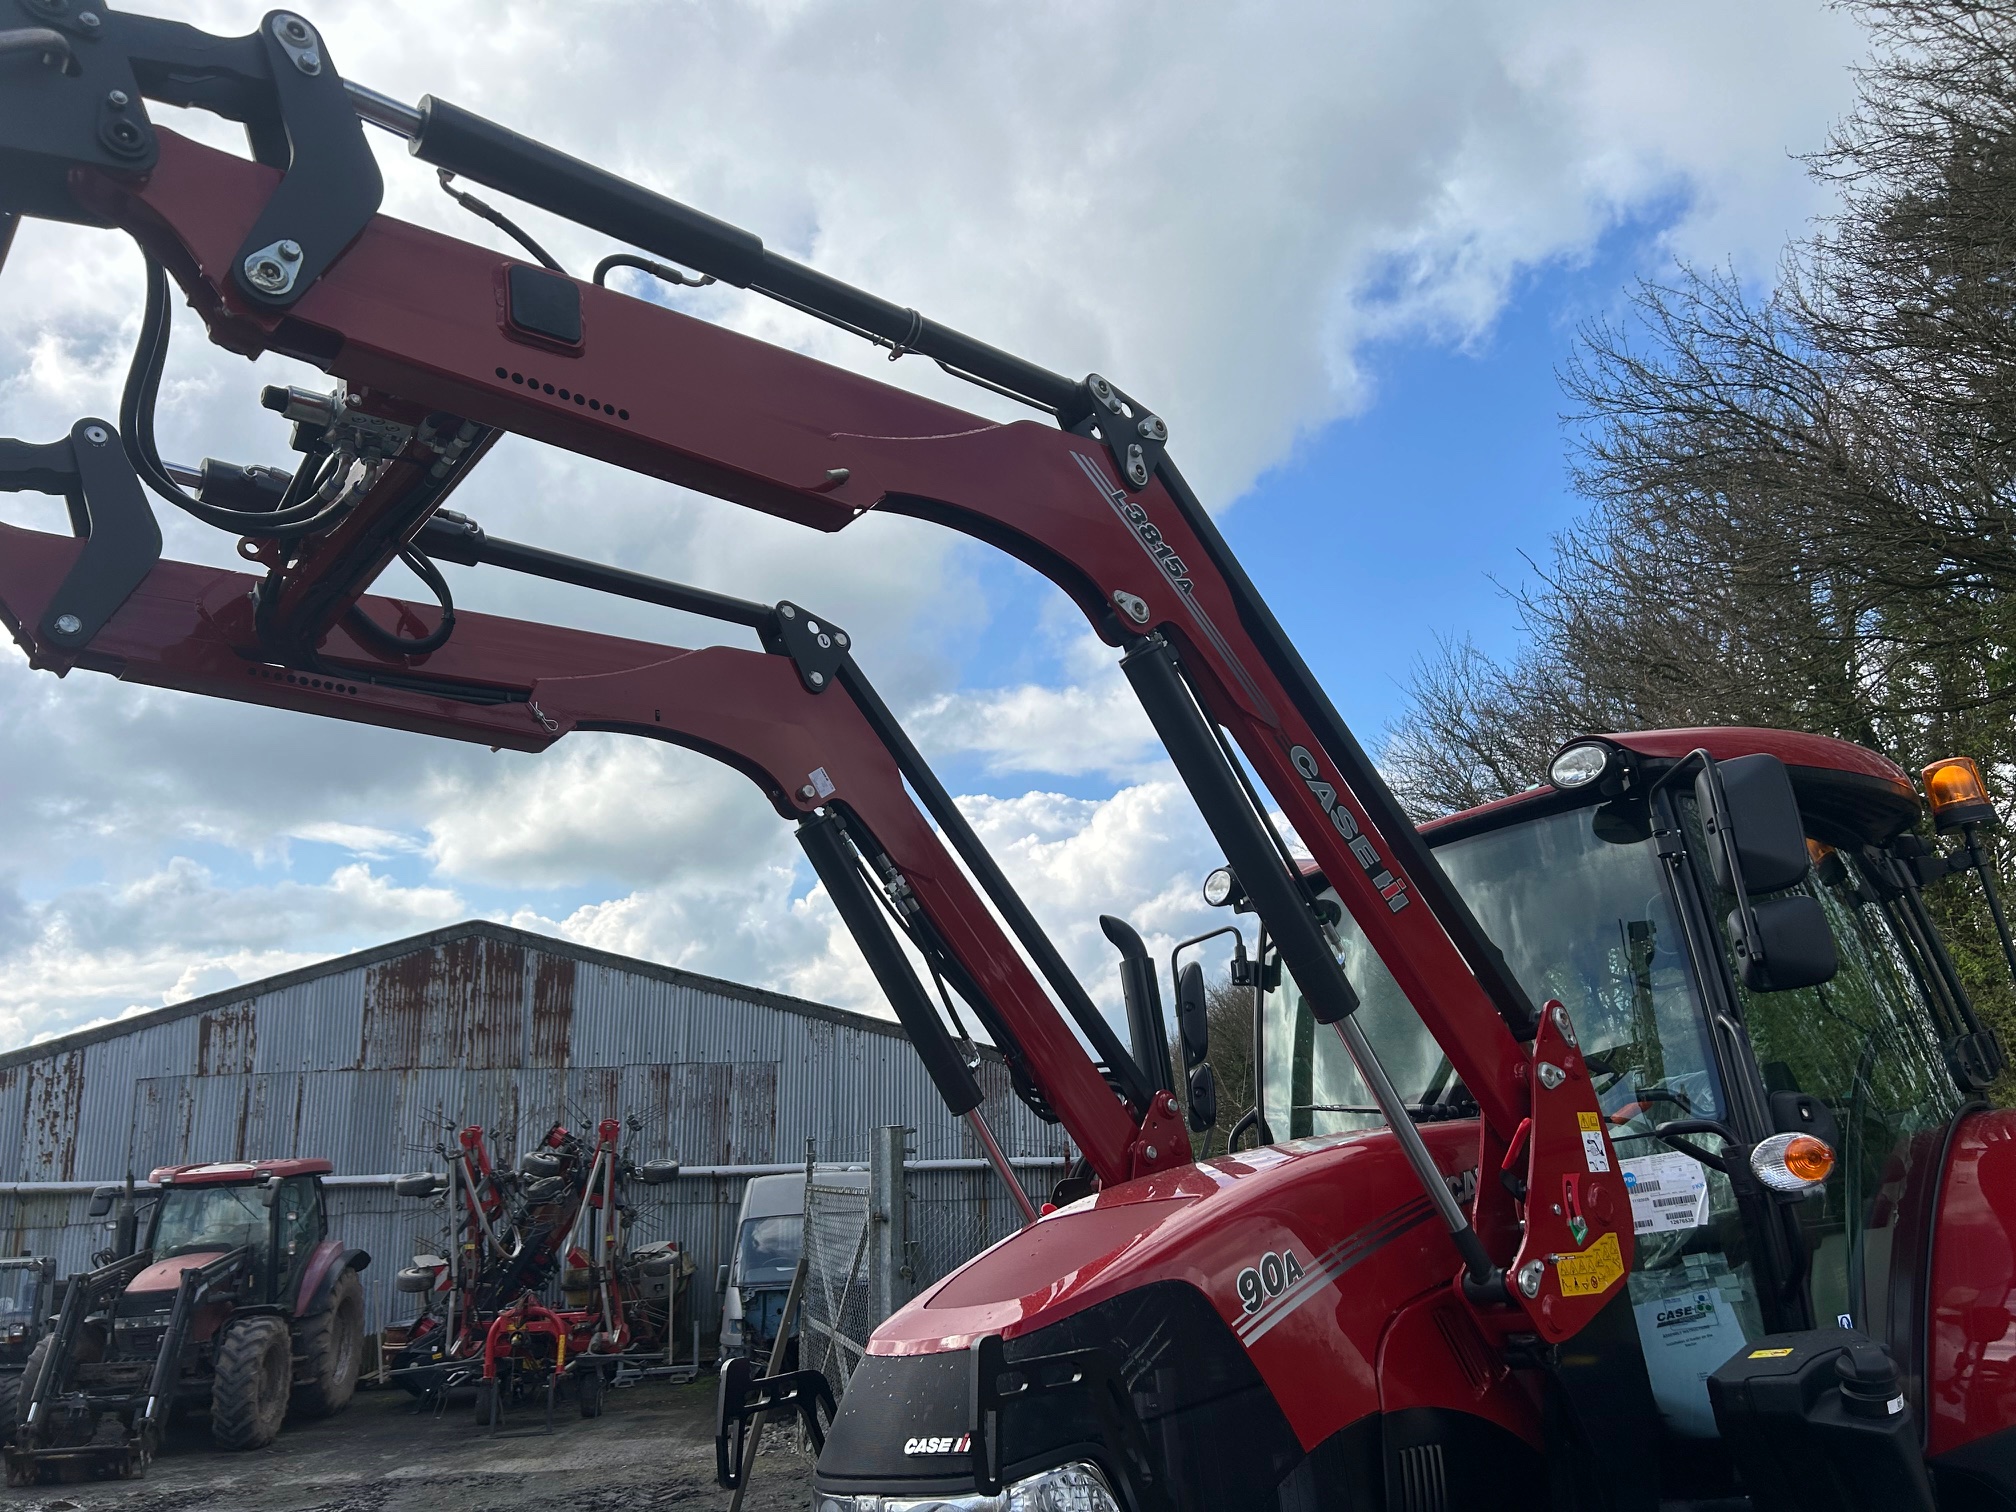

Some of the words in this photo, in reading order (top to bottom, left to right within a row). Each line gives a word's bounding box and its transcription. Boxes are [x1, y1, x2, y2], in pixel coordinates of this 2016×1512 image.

[1111, 488, 1194, 596] L3815A
[1290, 744, 1381, 869] CASE
[1236, 1249, 1305, 1315] 90A
[1656, 1306, 1693, 1322] CASE
[904, 1437, 953, 1454] CASE
